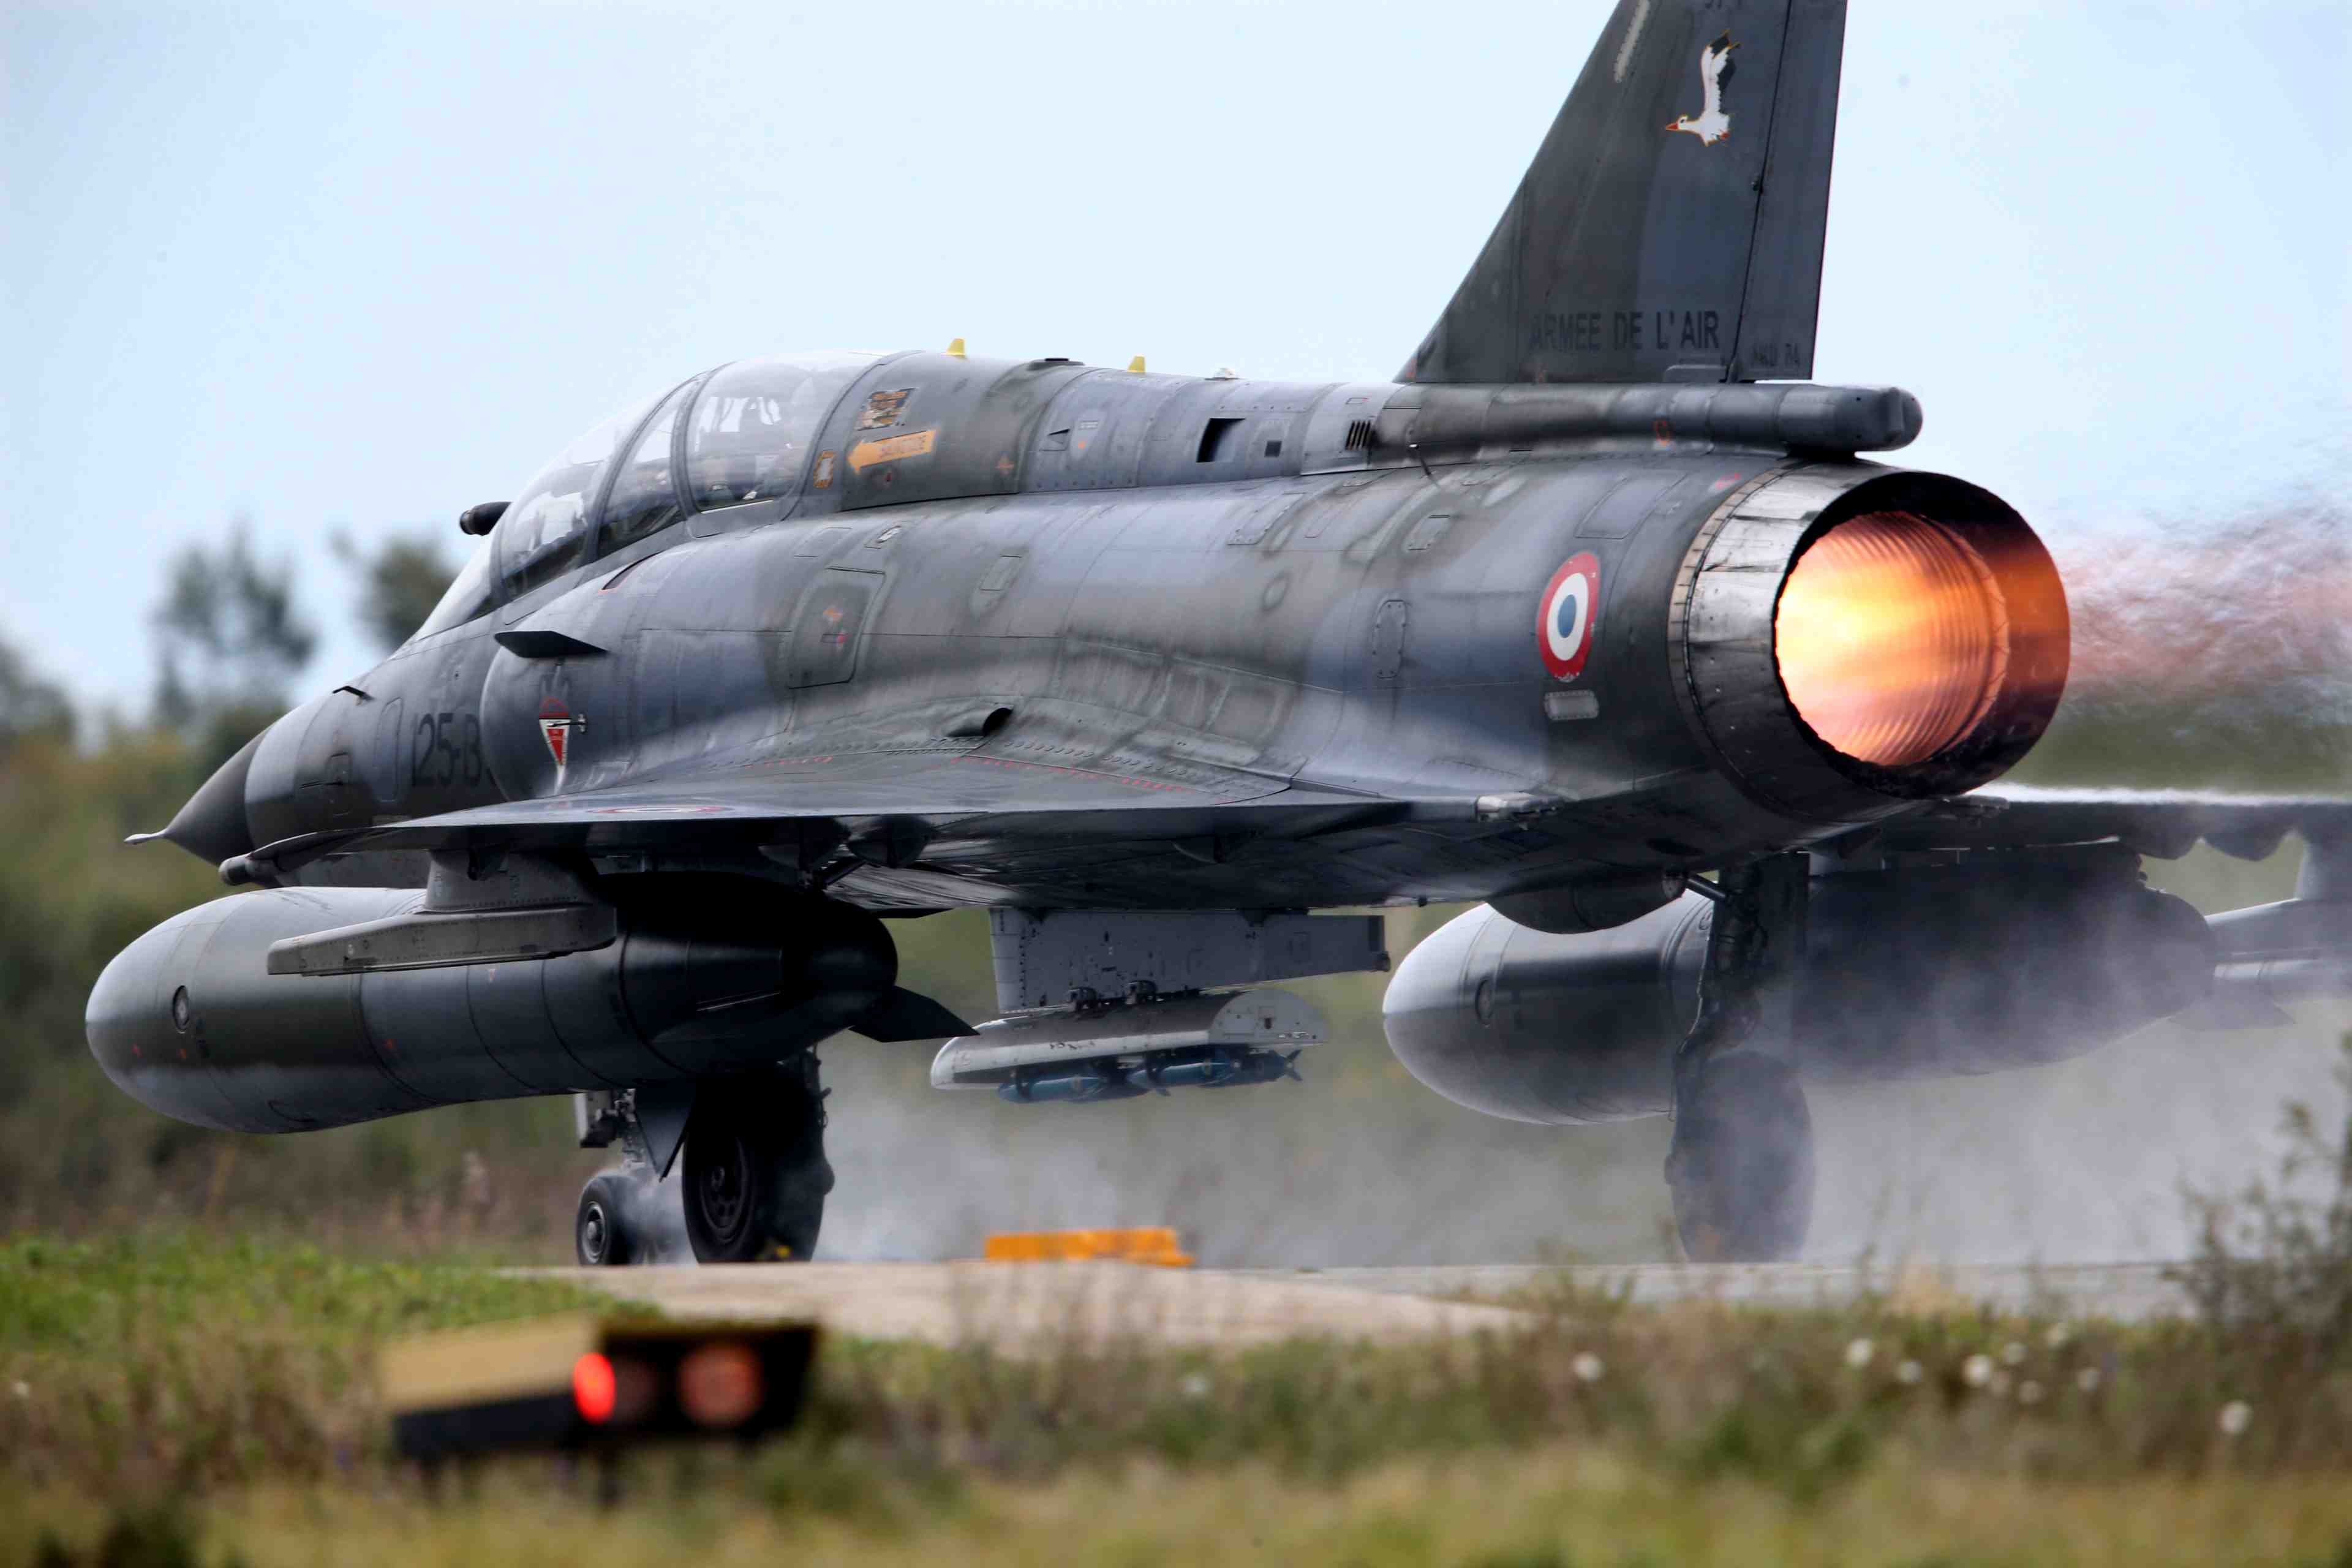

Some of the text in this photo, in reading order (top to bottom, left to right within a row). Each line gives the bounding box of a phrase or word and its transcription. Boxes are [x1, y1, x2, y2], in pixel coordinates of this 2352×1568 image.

[1529, 309, 1719, 353] ARMEE DE L'AIR
